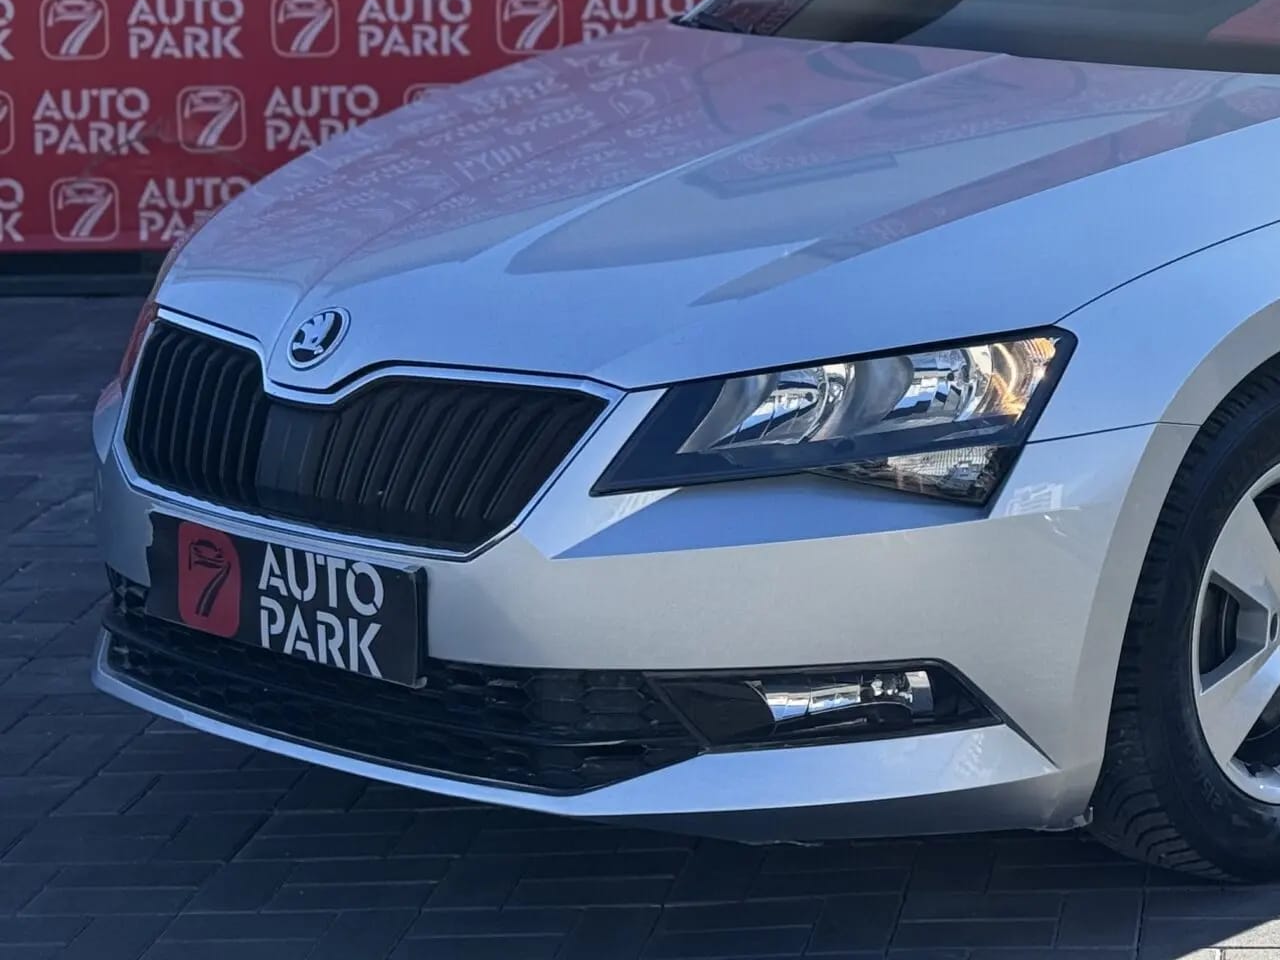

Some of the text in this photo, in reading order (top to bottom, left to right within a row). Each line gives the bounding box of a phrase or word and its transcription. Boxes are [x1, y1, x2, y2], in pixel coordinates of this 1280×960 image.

[129, 27, 241, 58] PARK
[359, 24, 469, 56] PARK
[33, 88, 149, 121] AUTO
[265, 85, 378, 119] AUTO
[35, 121, 149, 154] PARK
[257, 542, 385, 617] AUTO
[258, 595, 382, 679] PARK
